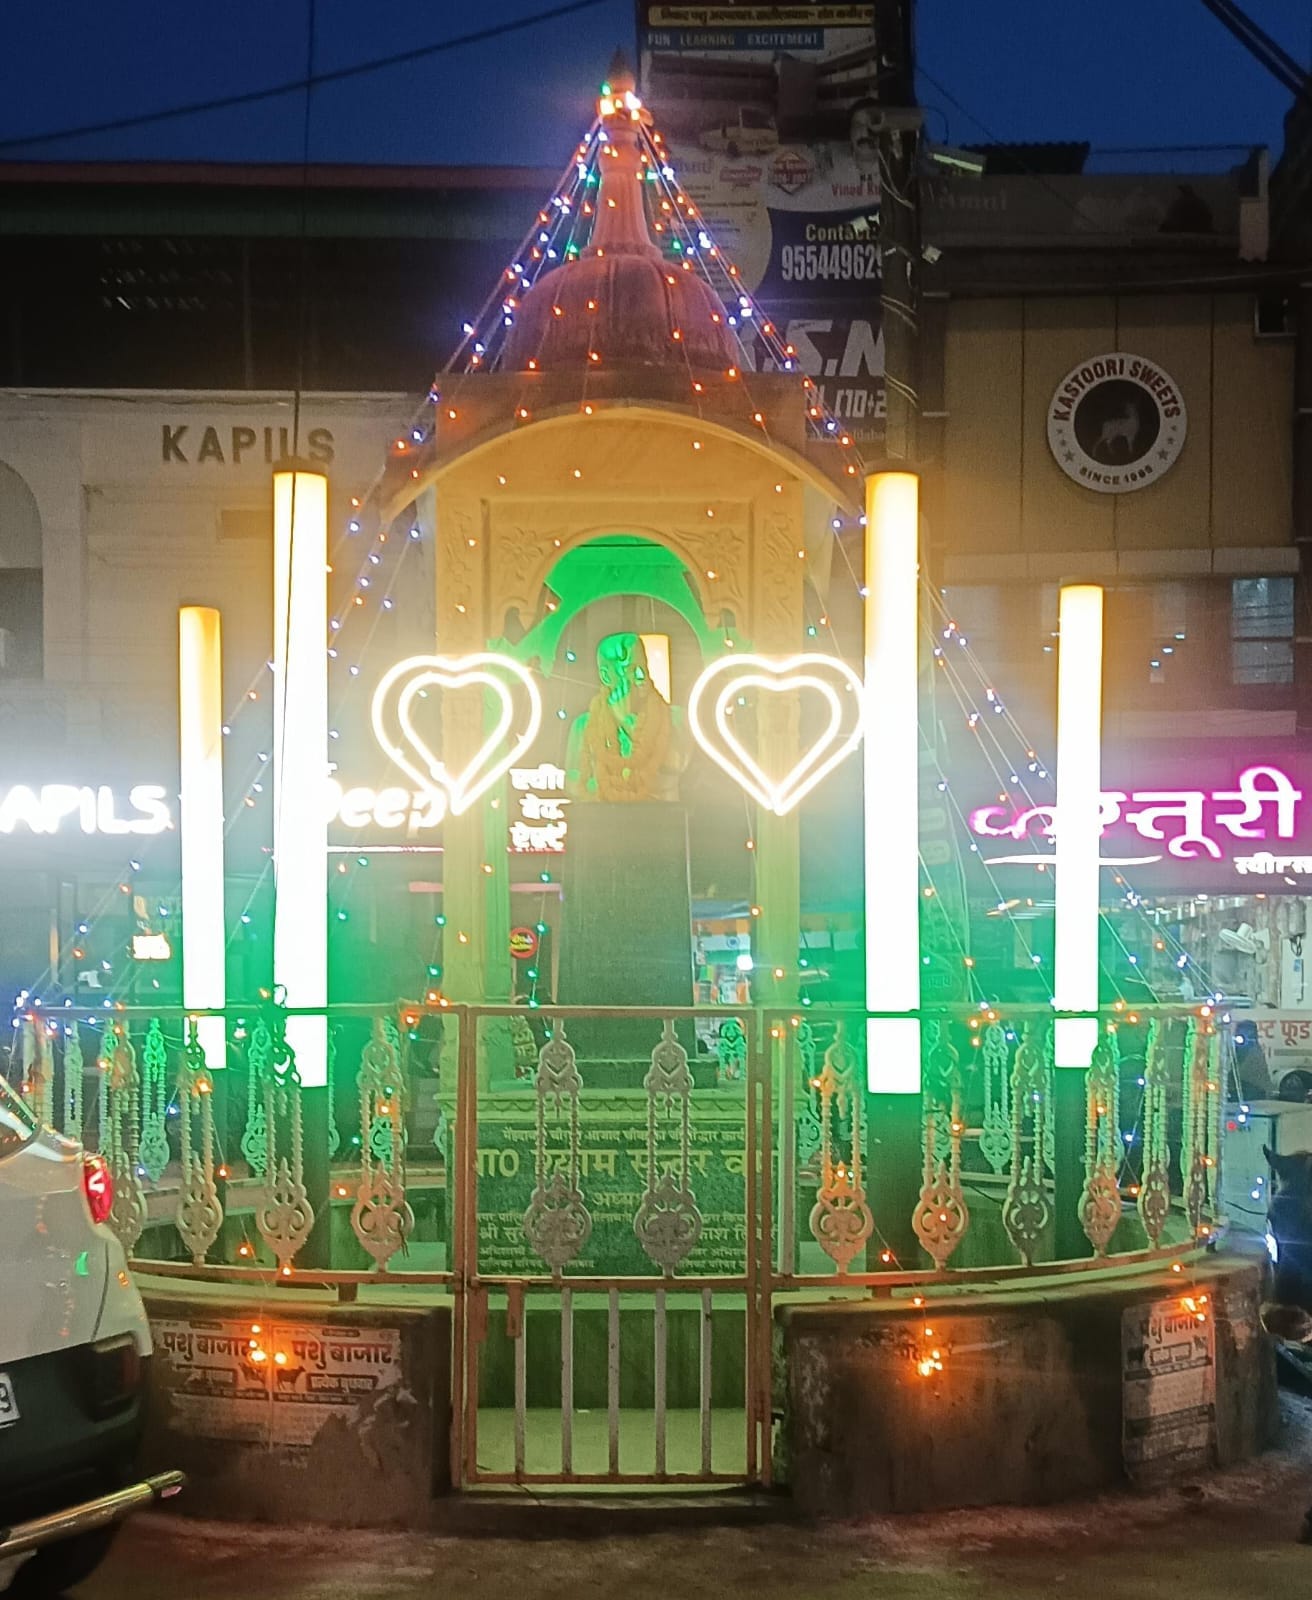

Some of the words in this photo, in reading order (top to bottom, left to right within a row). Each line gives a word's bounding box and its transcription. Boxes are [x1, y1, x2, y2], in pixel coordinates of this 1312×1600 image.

[648, 31, 671, 46] FUN
[680, 31, 736, 46] LEARNING
[747, 31, 819, 46] EXCITEMENT
[1053, 357, 1125, 422] KASTOORI
[1128, 360, 1182, 419] SWEETS
[1078, 466, 1120, 485] SINCE
[1280, 1019, 1312, 1046] फूड
[163, 1331, 195, 1361] पशु
[291, 1338, 327, 1368] पशु
[329, 1341, 394, 1365] बाजार
